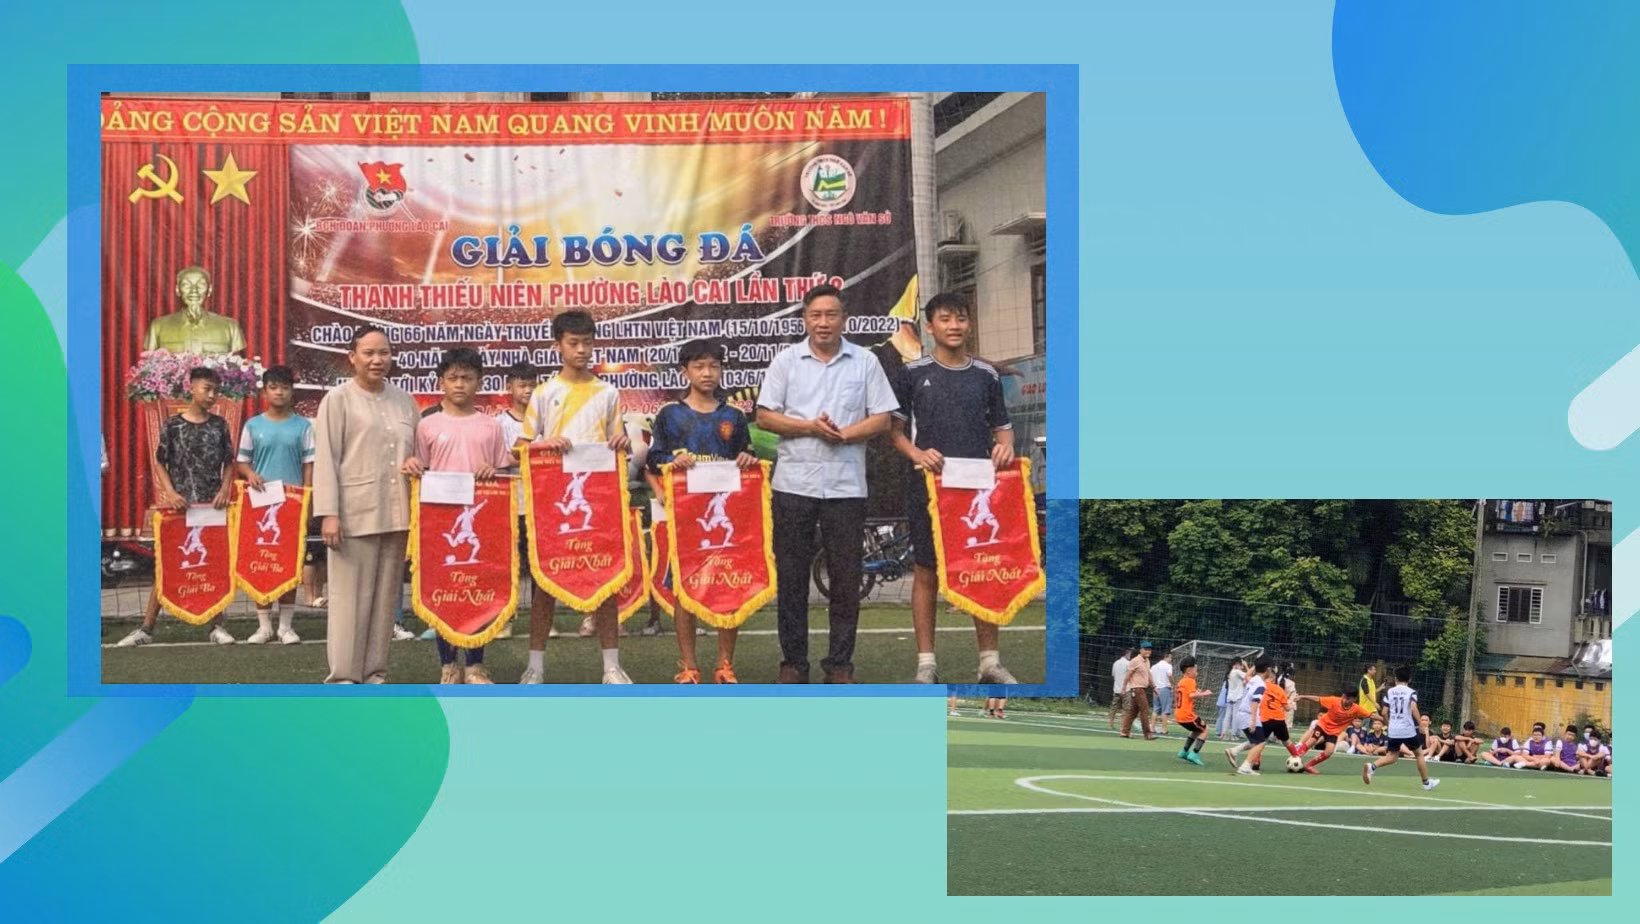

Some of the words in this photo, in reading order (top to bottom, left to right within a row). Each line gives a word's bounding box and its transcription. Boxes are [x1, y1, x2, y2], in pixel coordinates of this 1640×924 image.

[101, 102, 174, 133] ẢNG
[183, 105, 271, 138] CỘNG
[279, 104, 341, 134] SẢN
[351, 108, 421, 140] VIỆT
[431, 114, 498, 134] NAM
[507, 113, 615, 135] QUANG
[624, 112, 698, 133] VINH
[709, 106, 795, 133] MUÔN
[804, 105, 873, 130] NĂM
[452, 224, 550, 267] GIẢI
[561, 226, 687, 265] BÓNG
[697, 223, 765, 263] ĐÁ
[340, 284, 414, 309] THANH
[420, 277, 483, 309] THIẾU
[490, 279, 543, 307] NIÊN
[550, 277, 640, 306] PHƯỜNG
[647, 277, 688, 305] LÀO
[694, 280, 730, 304] CAI
[735, 270, 778, 303] LẦN
[311, 322, 353, 344] CHÀO
[403, 326, 421, 343] 66
[425, 321, 460, 343] NĂM
[463, 320, 502, 342] NGÀY
[615, 320, 653, 340] LHTN
[654, 317, 686, 341] VIỆT
[686, 319, 721, 338] NAM
[397, 350, 416, 369] 40
[604, 346, 641, 365] NAM
[483, 375, 500, 393] 30
